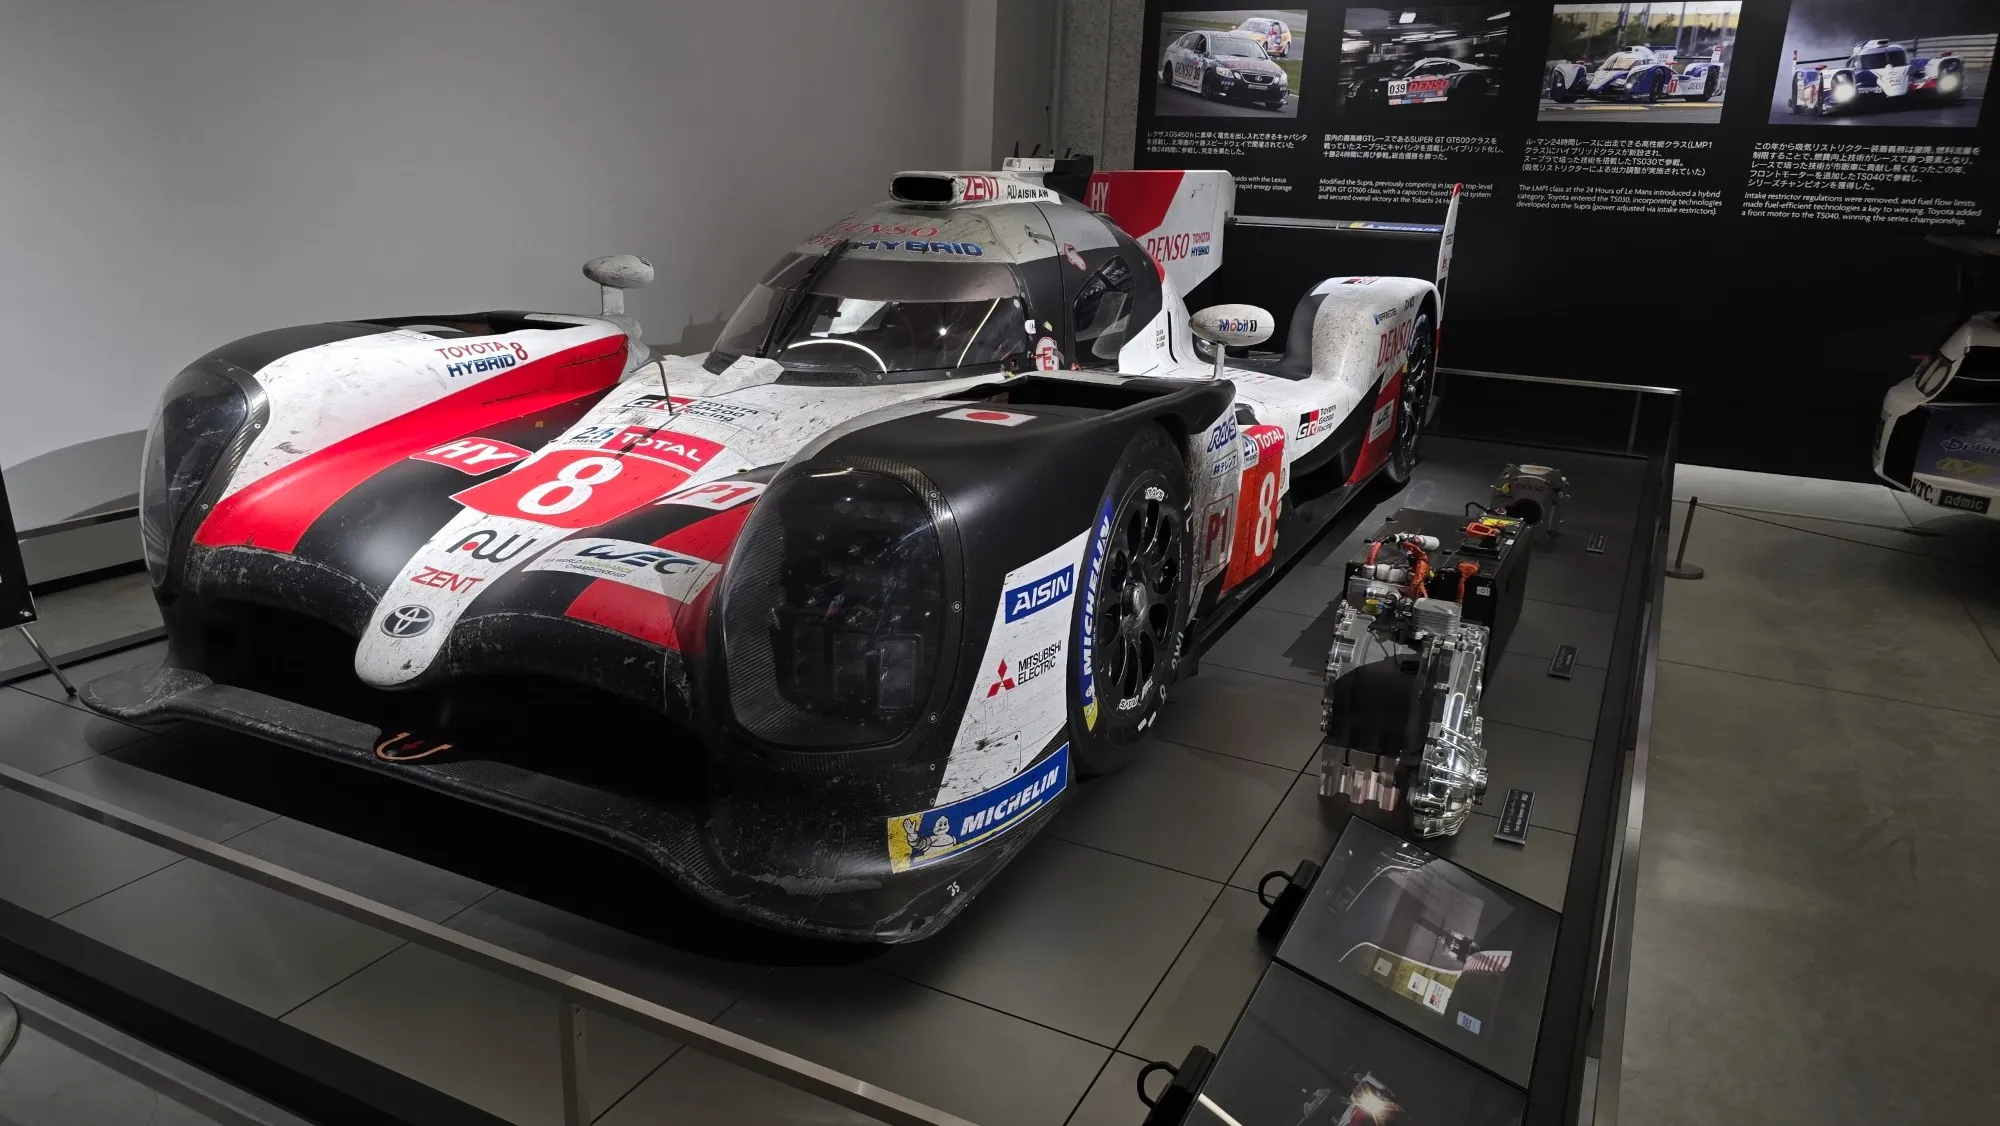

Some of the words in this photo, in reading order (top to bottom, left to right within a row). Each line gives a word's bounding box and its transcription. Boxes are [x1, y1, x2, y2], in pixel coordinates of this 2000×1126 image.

[1390, 84, 1406, 94] 039
[1409, 80, 1449, 92] DENSO
[960, 176, 1000, 200] ZENT
[1018, 188, 1036, 199] AISIN
[1039, 189, 1048, 198] AW
[1239, 183, 1252, 191] rapid
[1253, 184, 1271, 192] energy
[1375, 180, 1404, 188] previously
[1402, 188, 1448, 197] capacitor-based
[1092, 182, 1109, 212] HY
[1372, 195, 1391, 203] victory
[1518, 193, 1545, 202] category.
[1548, 194, 1569, 202] Toyota
[1632, 197, 1676, 207] incorporating
[1678, 198, 1723, 207] technologies
[1654, 189, 1690, 197] introduced
[1698, 190, 1721, 199] hybrid
[1745, 192, 1767, 200] Intake
[1768, 193, 1802, 201] restrictor
[1803, 194, 1843, 203] regulations
[1917, 198, 1933, 206] fuel
[1934, 198, 1952, 207] flow
[1953, 199, 1976, 207] limits
[1516, 201, 1549, 209] developed
[1561, 202, 1572, 210] the
[1574, 203, 1591, 211] Supra
[1592, 203, 1615, 212] (power
[1617, 204, 1645, 213] adjusted
[1657, 206, 1677, 214] intake
[1743, 201, 1763, 209] made
[1764, 202, 1812, 211] fuel-efficient
[1813, 203, 1860, 213] technologies
[1868, 205, 1882, 214] key
[1927, 208, 1954, 217] Toyota
[1955, 209, 1982, 217] added
[1748, 209, 1765, 217] front
[1802, 211, 1814, 219] the
[1843, 213, 1871, 223] winning
[1873, 214, 1885, 222] the
[1887, 215, 1909, 223] series
[1910, 215, 1966, 226] championship.
[1192, 232, 1211, 242] TOYOTA
[850, 240, 984, 257] HYBRID
[1147, 233, 1190, 262] DENSO
[1191, 245, 1210, 257] HYBRID
[1219, 318, 1248, 332] Mobil
[435, 342, 508, 360] TOYOTA
[510, 342, 528, 360] 8
[1377, 319, 1412, 368] DENSO
[446, 354, 516, 377] HYBRID
[1043, 346, 1053, 370] E
[684, 409, 736, 422] Racing
[686, 405, 746, 418] GAZOO
[699, 400, 759, 415] TOYOTA
[1207, 415, 1237, 452] RAYS
[1254, 428, 1284, 450] TOTAL
[1297, 420, 1317, 440] GR
[426, 440, 518, 466] HY
[621, 432, 702, 462] TOTAL
[517, 456, 624, 515] 8
[678, 484, 758, 504] P1
[1516, 483, 1545, 492] DENSO
[1255, 472, 1275, 556] 8
[1206, 507, 1229, 561] P1
[576, 544, 699, 574] WEC
[582, 560, 633, 574] ENDURANCE
[410, 566, 484, 594] ZENT
[565, 564, 627, 578] CHAMPIONSHIP
[1012, 572, 1070, 616] AISIN
[1084, 515, 1110, 675] MICHELIN
[1018, 640, 1062, 672] MITSUBISHI
[1018, 657, 1056, 685] ELECTRIC
[960, 766, 1059, 836] MICHELIN
